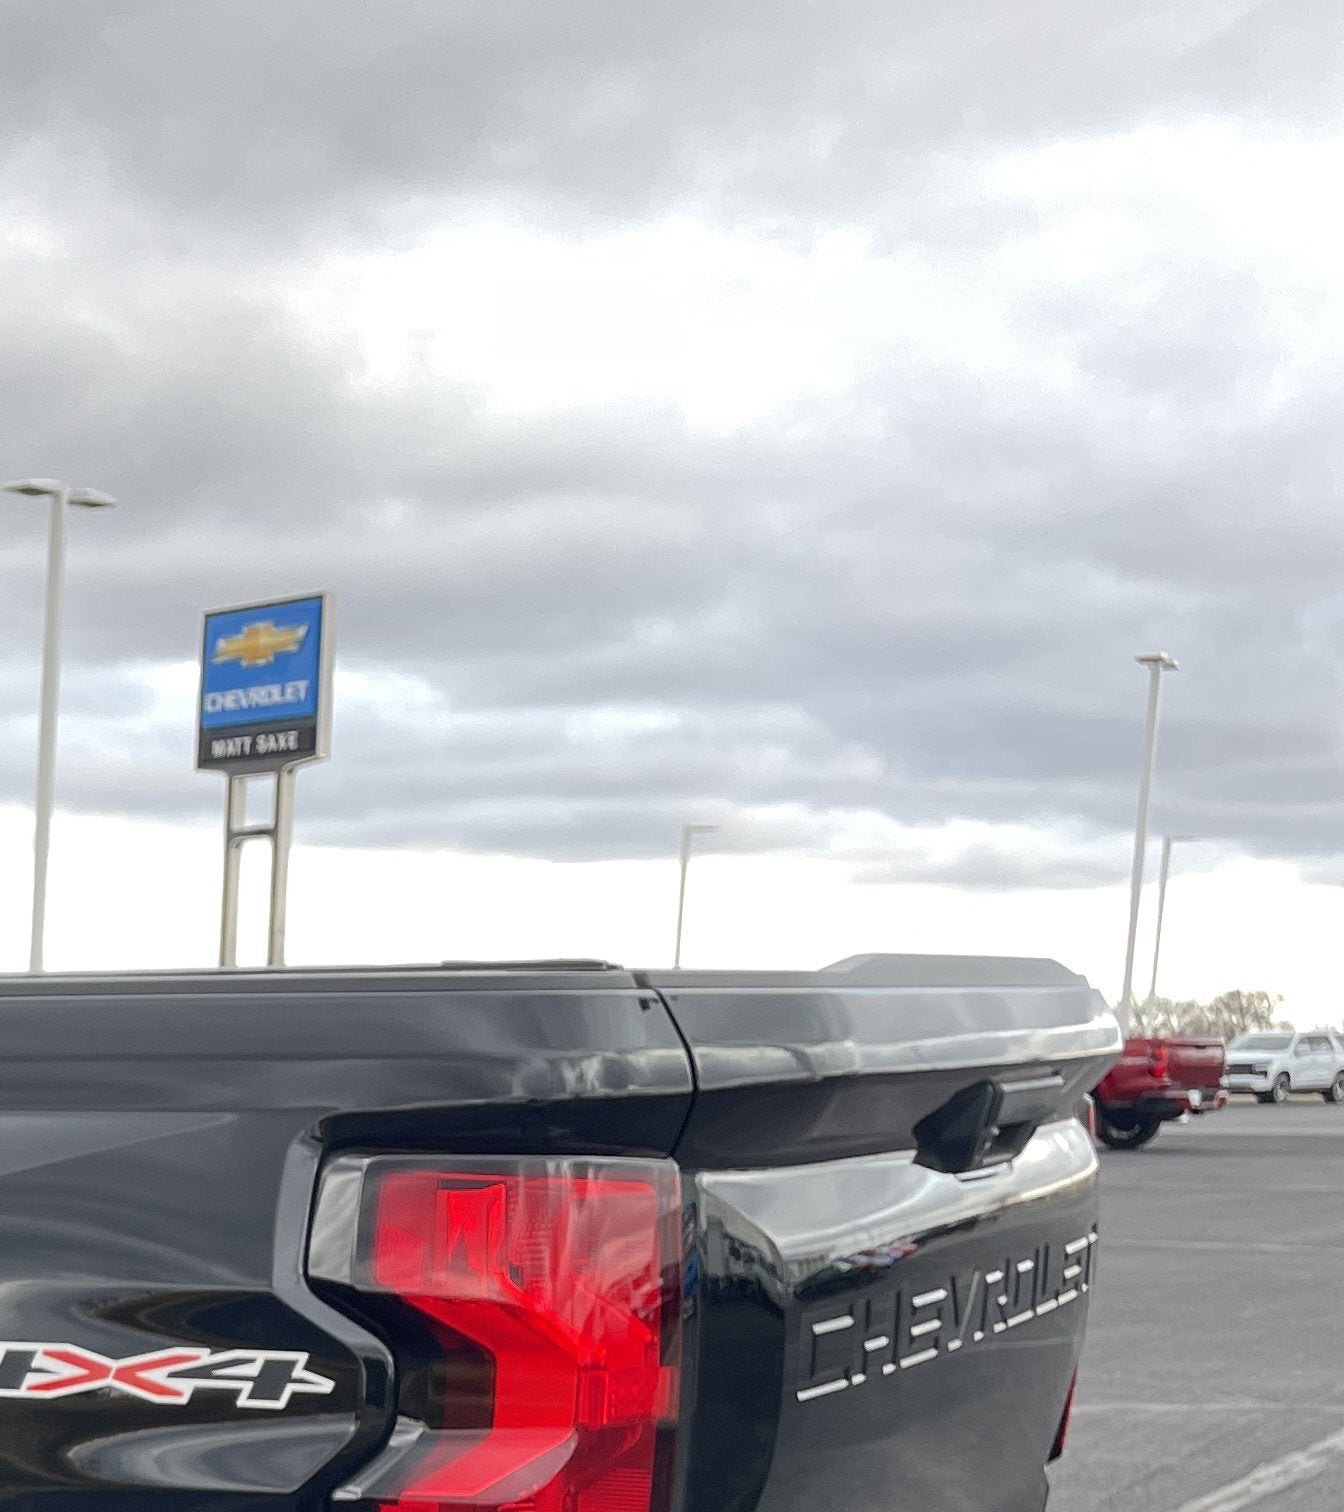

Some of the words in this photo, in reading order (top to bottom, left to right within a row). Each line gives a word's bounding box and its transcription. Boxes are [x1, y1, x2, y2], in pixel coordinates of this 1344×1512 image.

[205, 680, 308, 712] CHEVROLET
[212, 736, 252, 757] MATT
[796, 1223, 1099, 1403] CHEVROLET
